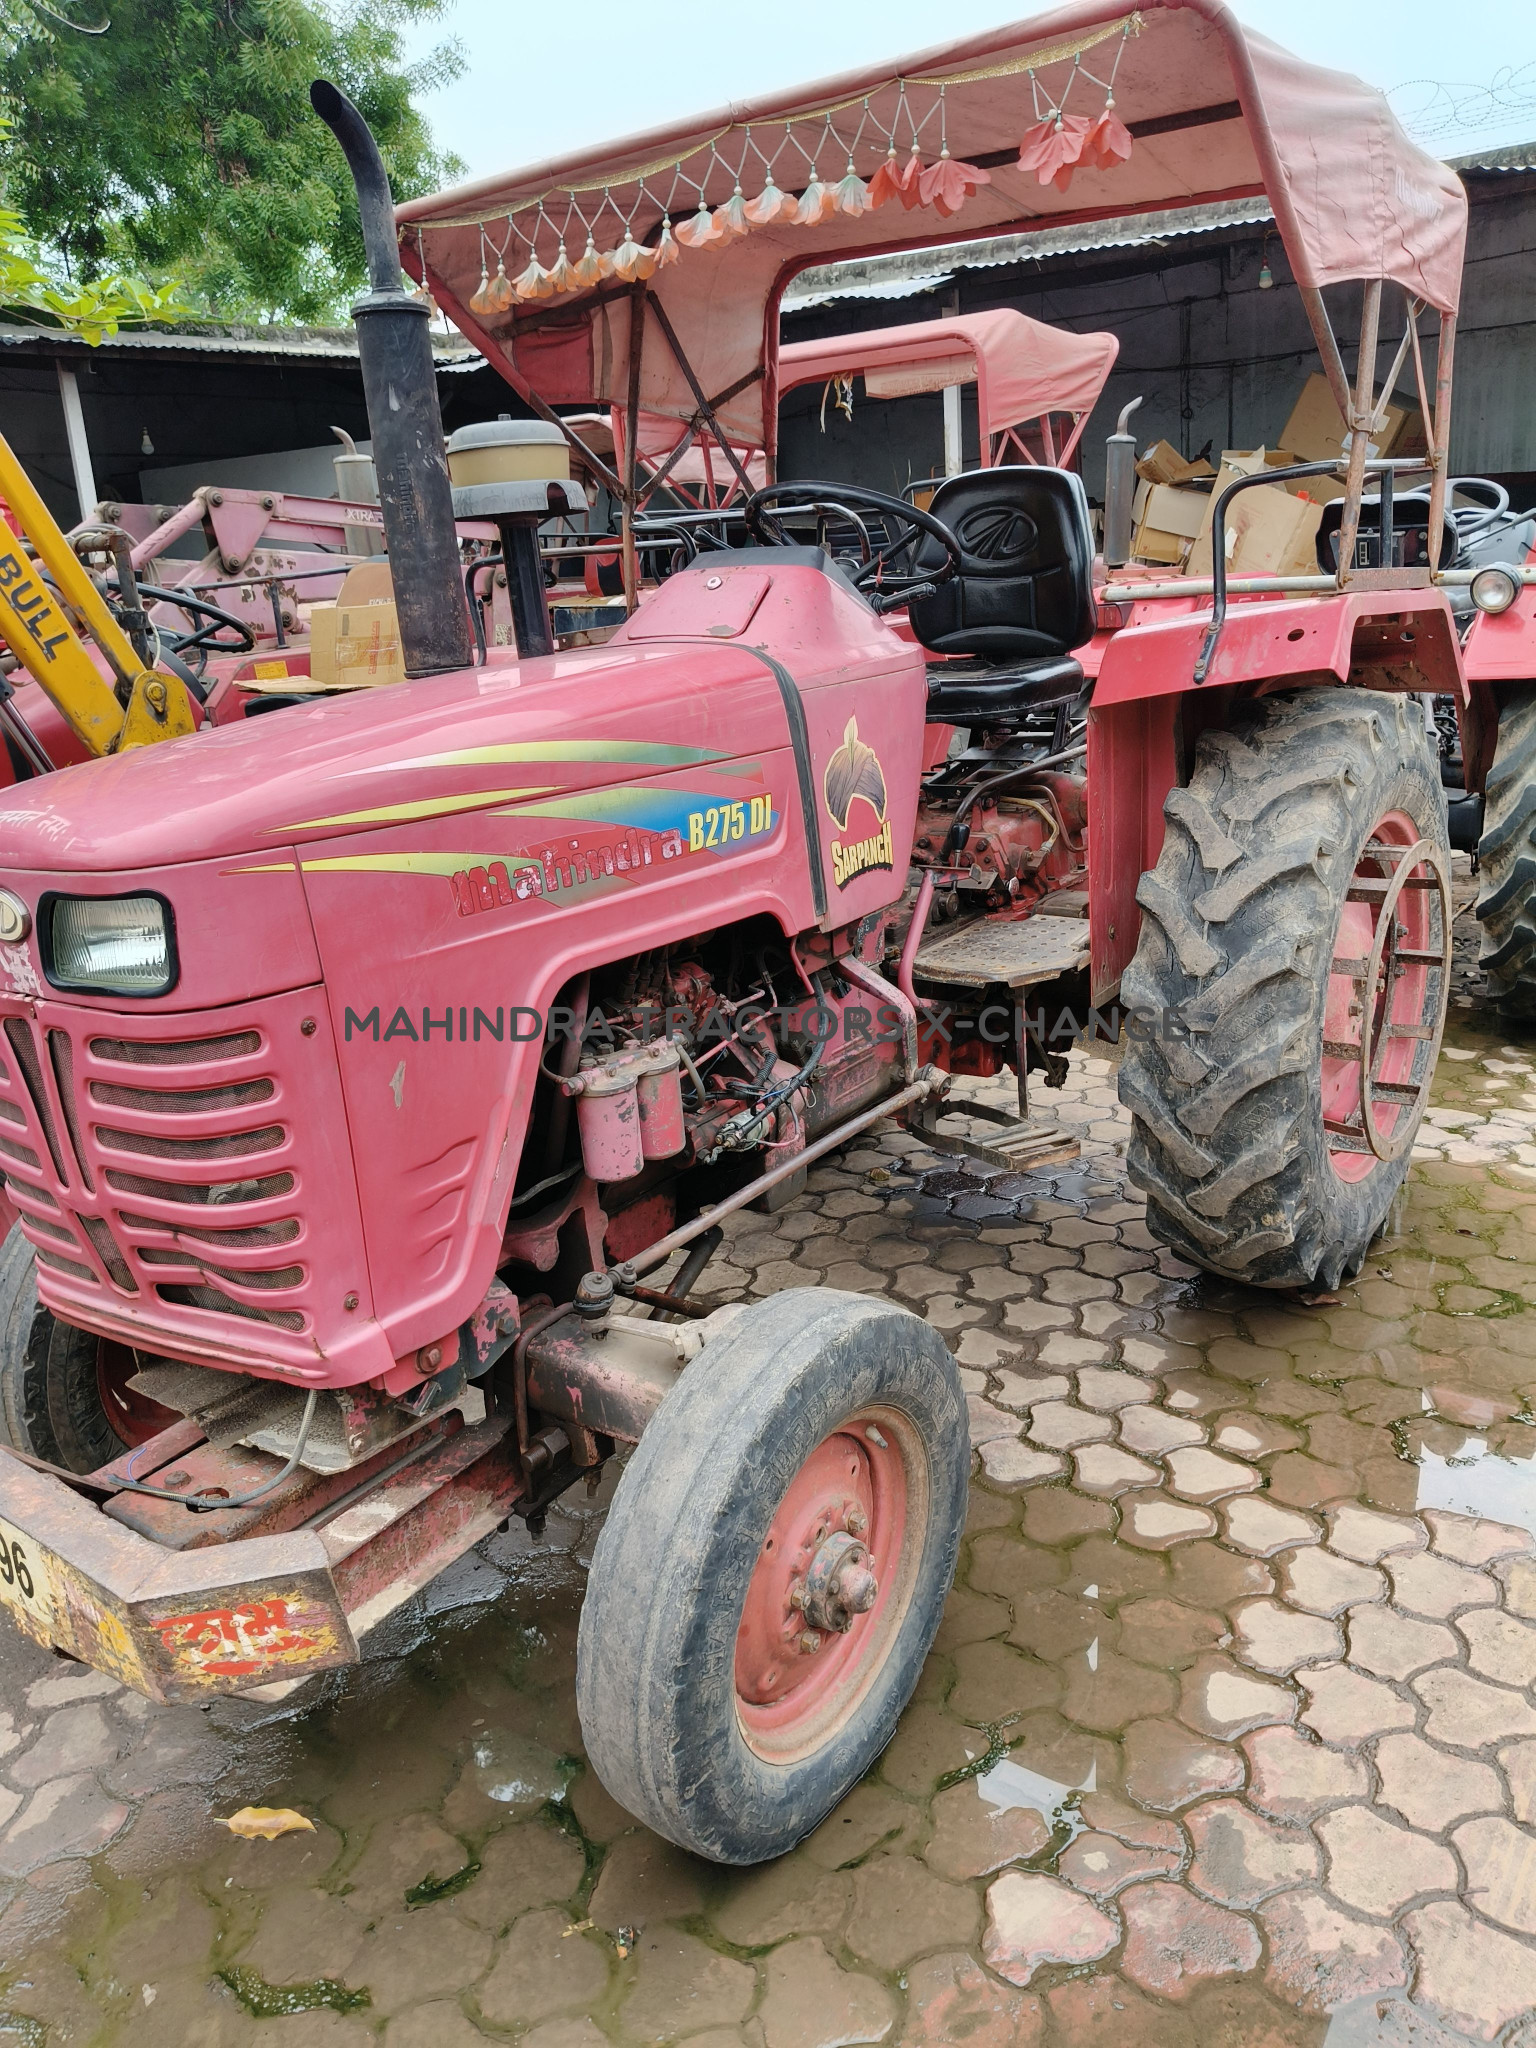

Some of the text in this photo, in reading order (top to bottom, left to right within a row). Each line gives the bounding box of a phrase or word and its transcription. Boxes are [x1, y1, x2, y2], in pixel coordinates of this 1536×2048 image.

[0, 554, 70, 661] BULL
[688, 793, 773, 853] B275 DI
[831, 820, 894, 887] SARPANCH
[0, 1532, 35, 1599] 96
